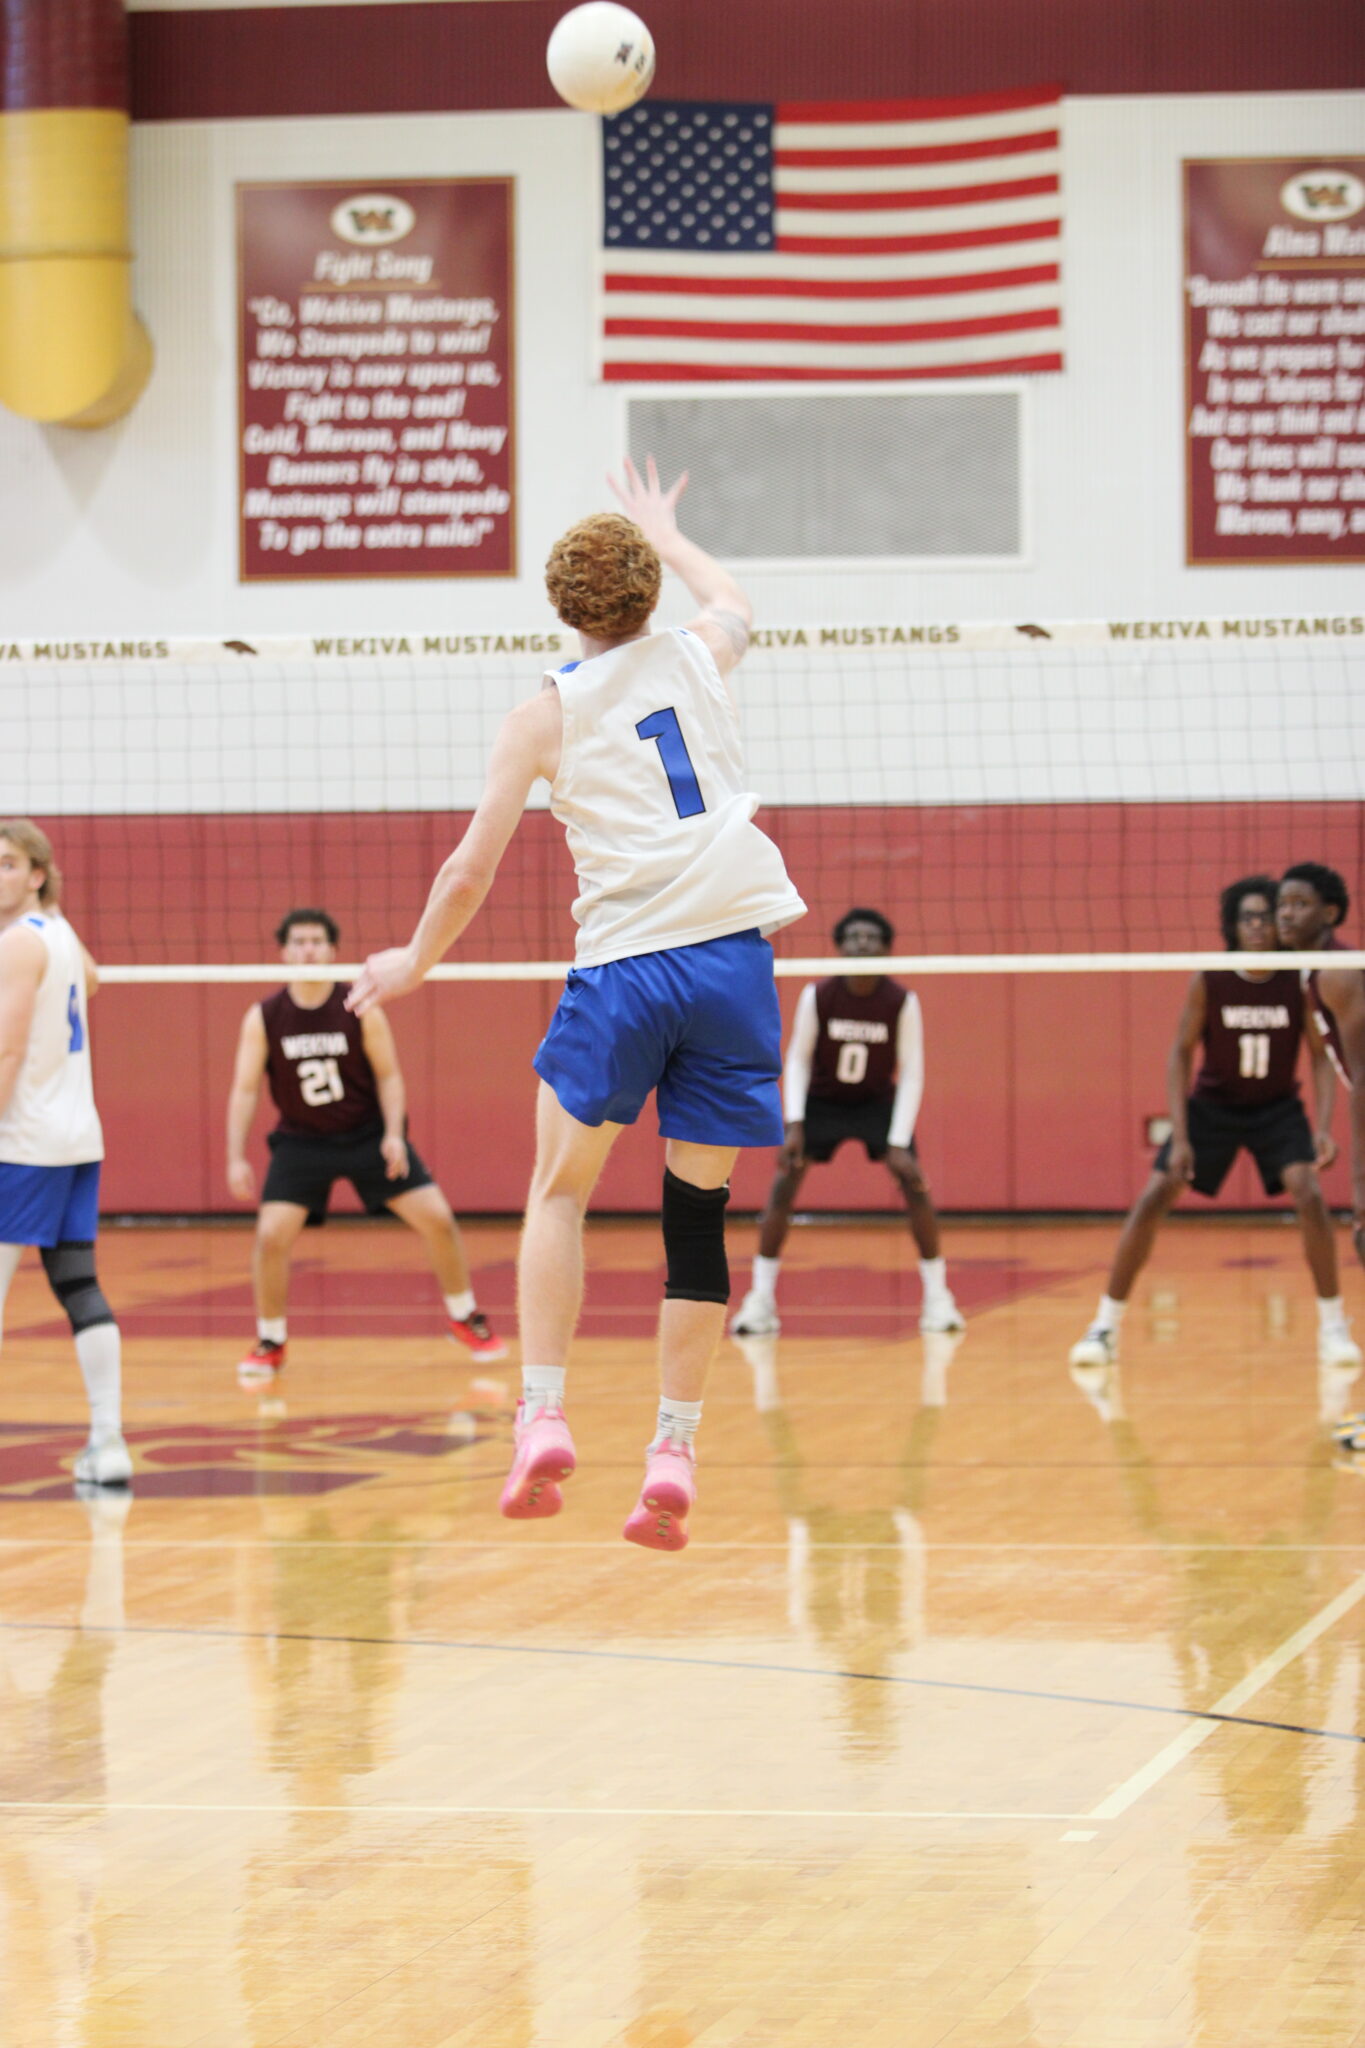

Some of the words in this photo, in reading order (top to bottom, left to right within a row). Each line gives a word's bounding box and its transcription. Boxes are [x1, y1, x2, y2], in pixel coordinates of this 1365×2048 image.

[314, 252, 372, 286] Fight
[374, 250, 433, 284] Song
[1261, 272, 1290, 305] the
[300, 295, 382, 325] Wekiva
[1206, 307, 1241, 337] We
[1286, 310, 1319, 336] our
[257, 328, 297, 358] We
[299, 327, 408, 361] Stampede
[410, 330, 436, 354] to
[1198, 338, 1227, 372] As
[1228, 344, 1259, 371] we
[1335, 336, 1364, 370] for
[249, 361, 328, 393] Victory
[329, 359, 352, 387] is
[354, 364, 406, 387] now
[408, 362, 464, 391] upon
[1231, 377, 1264, 404] our
[1333, 368, 1363, 401] for
[283, 390, 343, 426] Fight
[345, 394, 370, 420] to
[372, 391, 410, 420] the
[400, 421, 446, 451] and
[447, 420, 508, 455] Navy
[1210, 436, 1247, 471] Our
[1297, 436, 1337, 469] will
[268, 455, 360, 486] Banners
[361, 453, 394, 489] fly
[395, 453, 420, 484] in
[1214, 471, 1248, 503] We
[1304, 474, 1339, 502] our
[243, 487, 351, 522] Mustangs
[353, 486, 401, 516] will
[401, 484, 511, 520] stampede
[259, 519, 288, 550] To
[289, 526, 321, 556] go
[323, 520, 362, 549] the
[363, 522, 423, 548] extra
[313, 637, 411, 656] WEKIVA
[424, 635, 562, 655] MUSTANGS
[820, 626, 958, 646] MUSTANGS
[1108, 621, 1209, 639] WEKIVA
[1222, 617, 1364, 637] MUSTANGS
[34, 641, 169, 660] MUSTANGS
[635, 706, 706, 819] 1
[836, 1042, 869, 1084] 0
[1239, 1033, 1270, 1079] 11
[297, 1058, 344, 1107] 21
